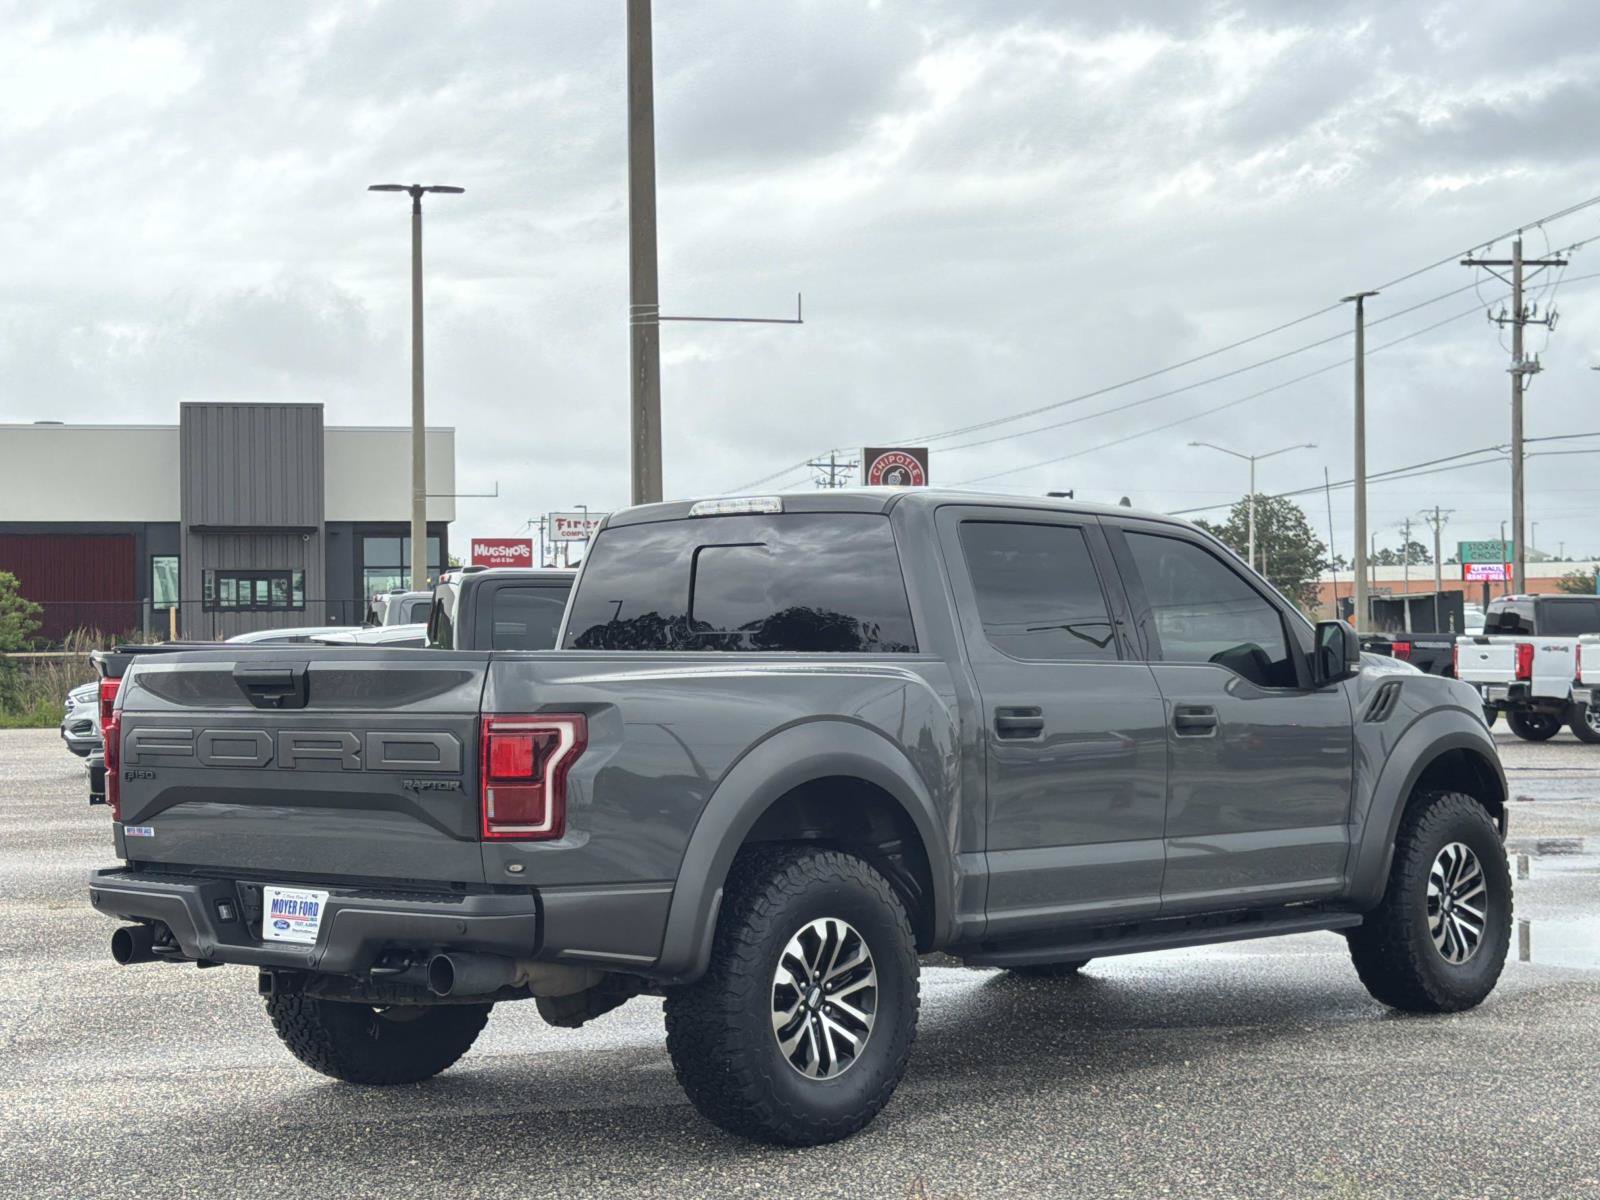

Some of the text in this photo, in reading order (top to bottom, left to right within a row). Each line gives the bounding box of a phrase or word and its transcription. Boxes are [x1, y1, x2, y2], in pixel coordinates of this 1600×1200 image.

[873, 455, 921, 477] CHIPOTLE
[1470, 551, 1505, 560] CHOIC
[124, 728, 463, 771] FORD
[401, 779, 466, 794] RAPTOR
[271, 898, 319, 917] MOYER FORD
